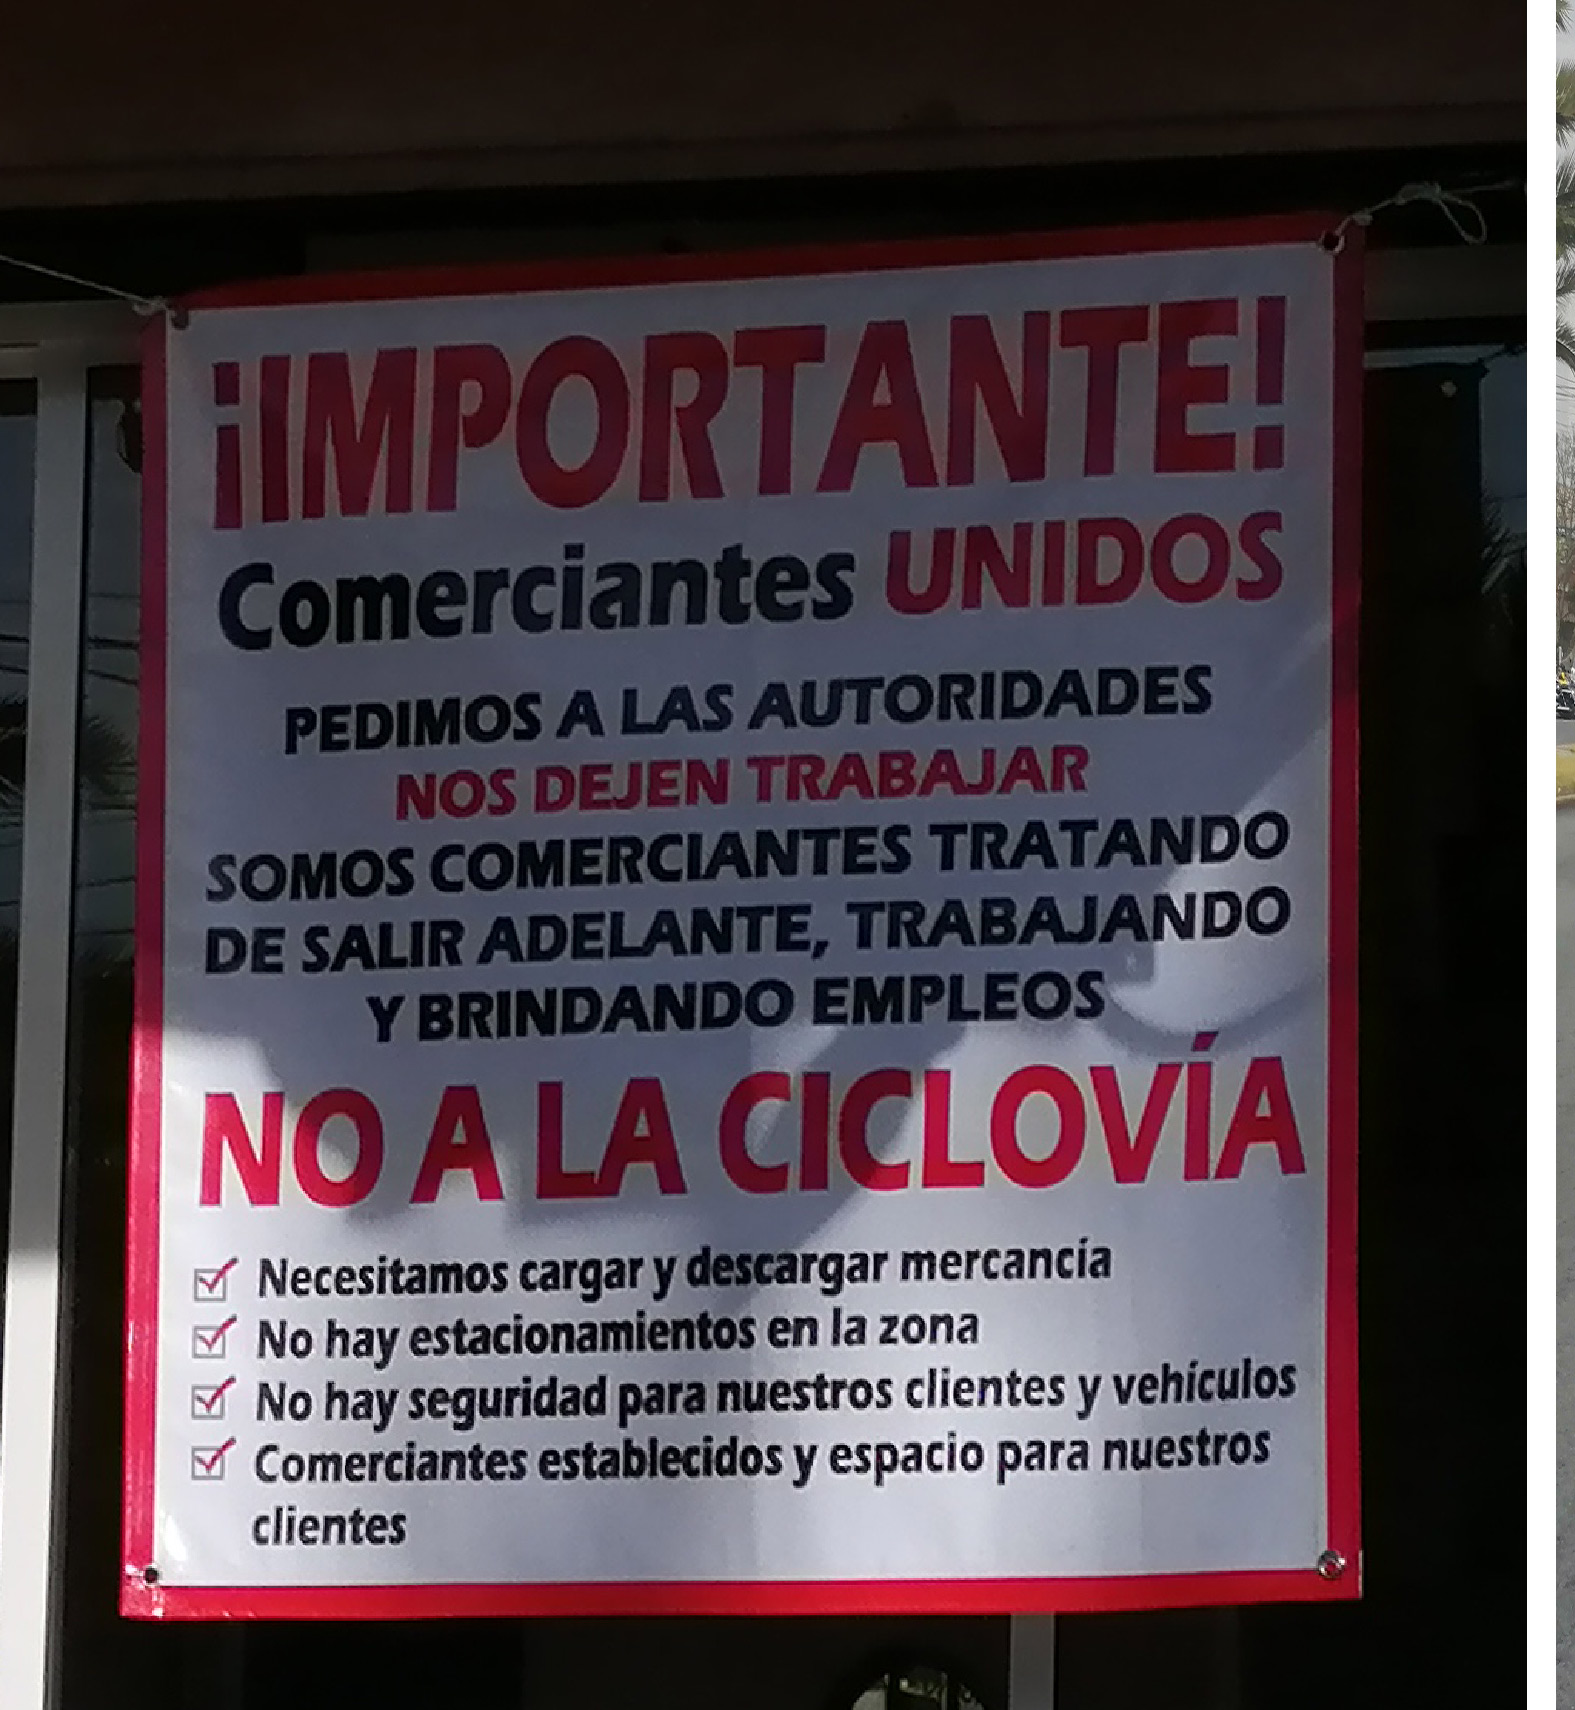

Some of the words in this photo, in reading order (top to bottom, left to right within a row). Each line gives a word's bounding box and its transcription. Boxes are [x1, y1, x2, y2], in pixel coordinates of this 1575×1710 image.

[212, 296, 1286, 530] ¡IMPORTANTE!
[219, 543, 855, 651] Comerciantes
[886, 511, 1283, 615] UNIDOS
[285, 692, 542, 755] PEDIMOS
[555, 690, 605, 739] A
[621, 684, 733, 735] LAS
[747, 665, 1212, 730] AUTORIDADES
[396, 768, 517, 820] NOS
[534, 758, 730, 813] DEJEN
[746, 745, 1089, 803] TRABAJAR
[206, 847, 415, 902] SOMOS
[429, 824, 911, 893] COMERCIANTES
[928, 811, 1289, 871] TRATANDO
[205, 927, 286, 974] DE
[302, 919, 465, 974] SALIR
[476, 903, 829, 965] ADELANTE,
[845, 886, 1291, 950] TRABAJANDO
[366, 994, 405, 1043] Y
[418, 978, 794, 1041] BRINDANDO
[812, 970, 1105, 1025] EMPLEOS
[200, 1088, 384, 1208] NO
[409, 1085, 504, 1204] A
[536, 1077, 688, 1199] LA
[719, 1031, 1306, 1194] CICLOVÍA
[259, 1255, 508, 1298] Necesitamos
[519, 1257, 644, 1303] cargar
[652, 1256, 677, 1302] y
[686, 1245, 889, 1297] descargar
[901, 1237, 1111, 1281] mercancía
[258, 1319, 313, 1359] No
[325, 1318, 400, 1371] hay
[409, 1309, 756, 1357] estacionamientos
[767, 1316, 818, 1348] en
[831, 1306, 867, 1347] la
[879, 1313, 978, 1344] zona
[257, 1381, 312, 1421] No
[325, 1381, 399, 1434] hay
[408, 1374, 607, 1432] seguridad
[618, 1381, 706, 1429] para
[717, 1373, 893, 1413] nuestros
[906, 1367, 1065, 1409] clientes
[1076, 1375, 1102, 1420] y
[1113, 1357, 1296, 1405] vehículos
[255, 1440, 528, 1483] Comerciantes
[538, 1435, 783, 1480] establecidos
[792, 1444, 818, 1488] y
[829, 1431, 984, 1486] espacio
[997, 1440, 1088, 1485] para
[1104, 1426, 1270, 1471] nuestros
[253, 1505, 406, 1545] clientes
